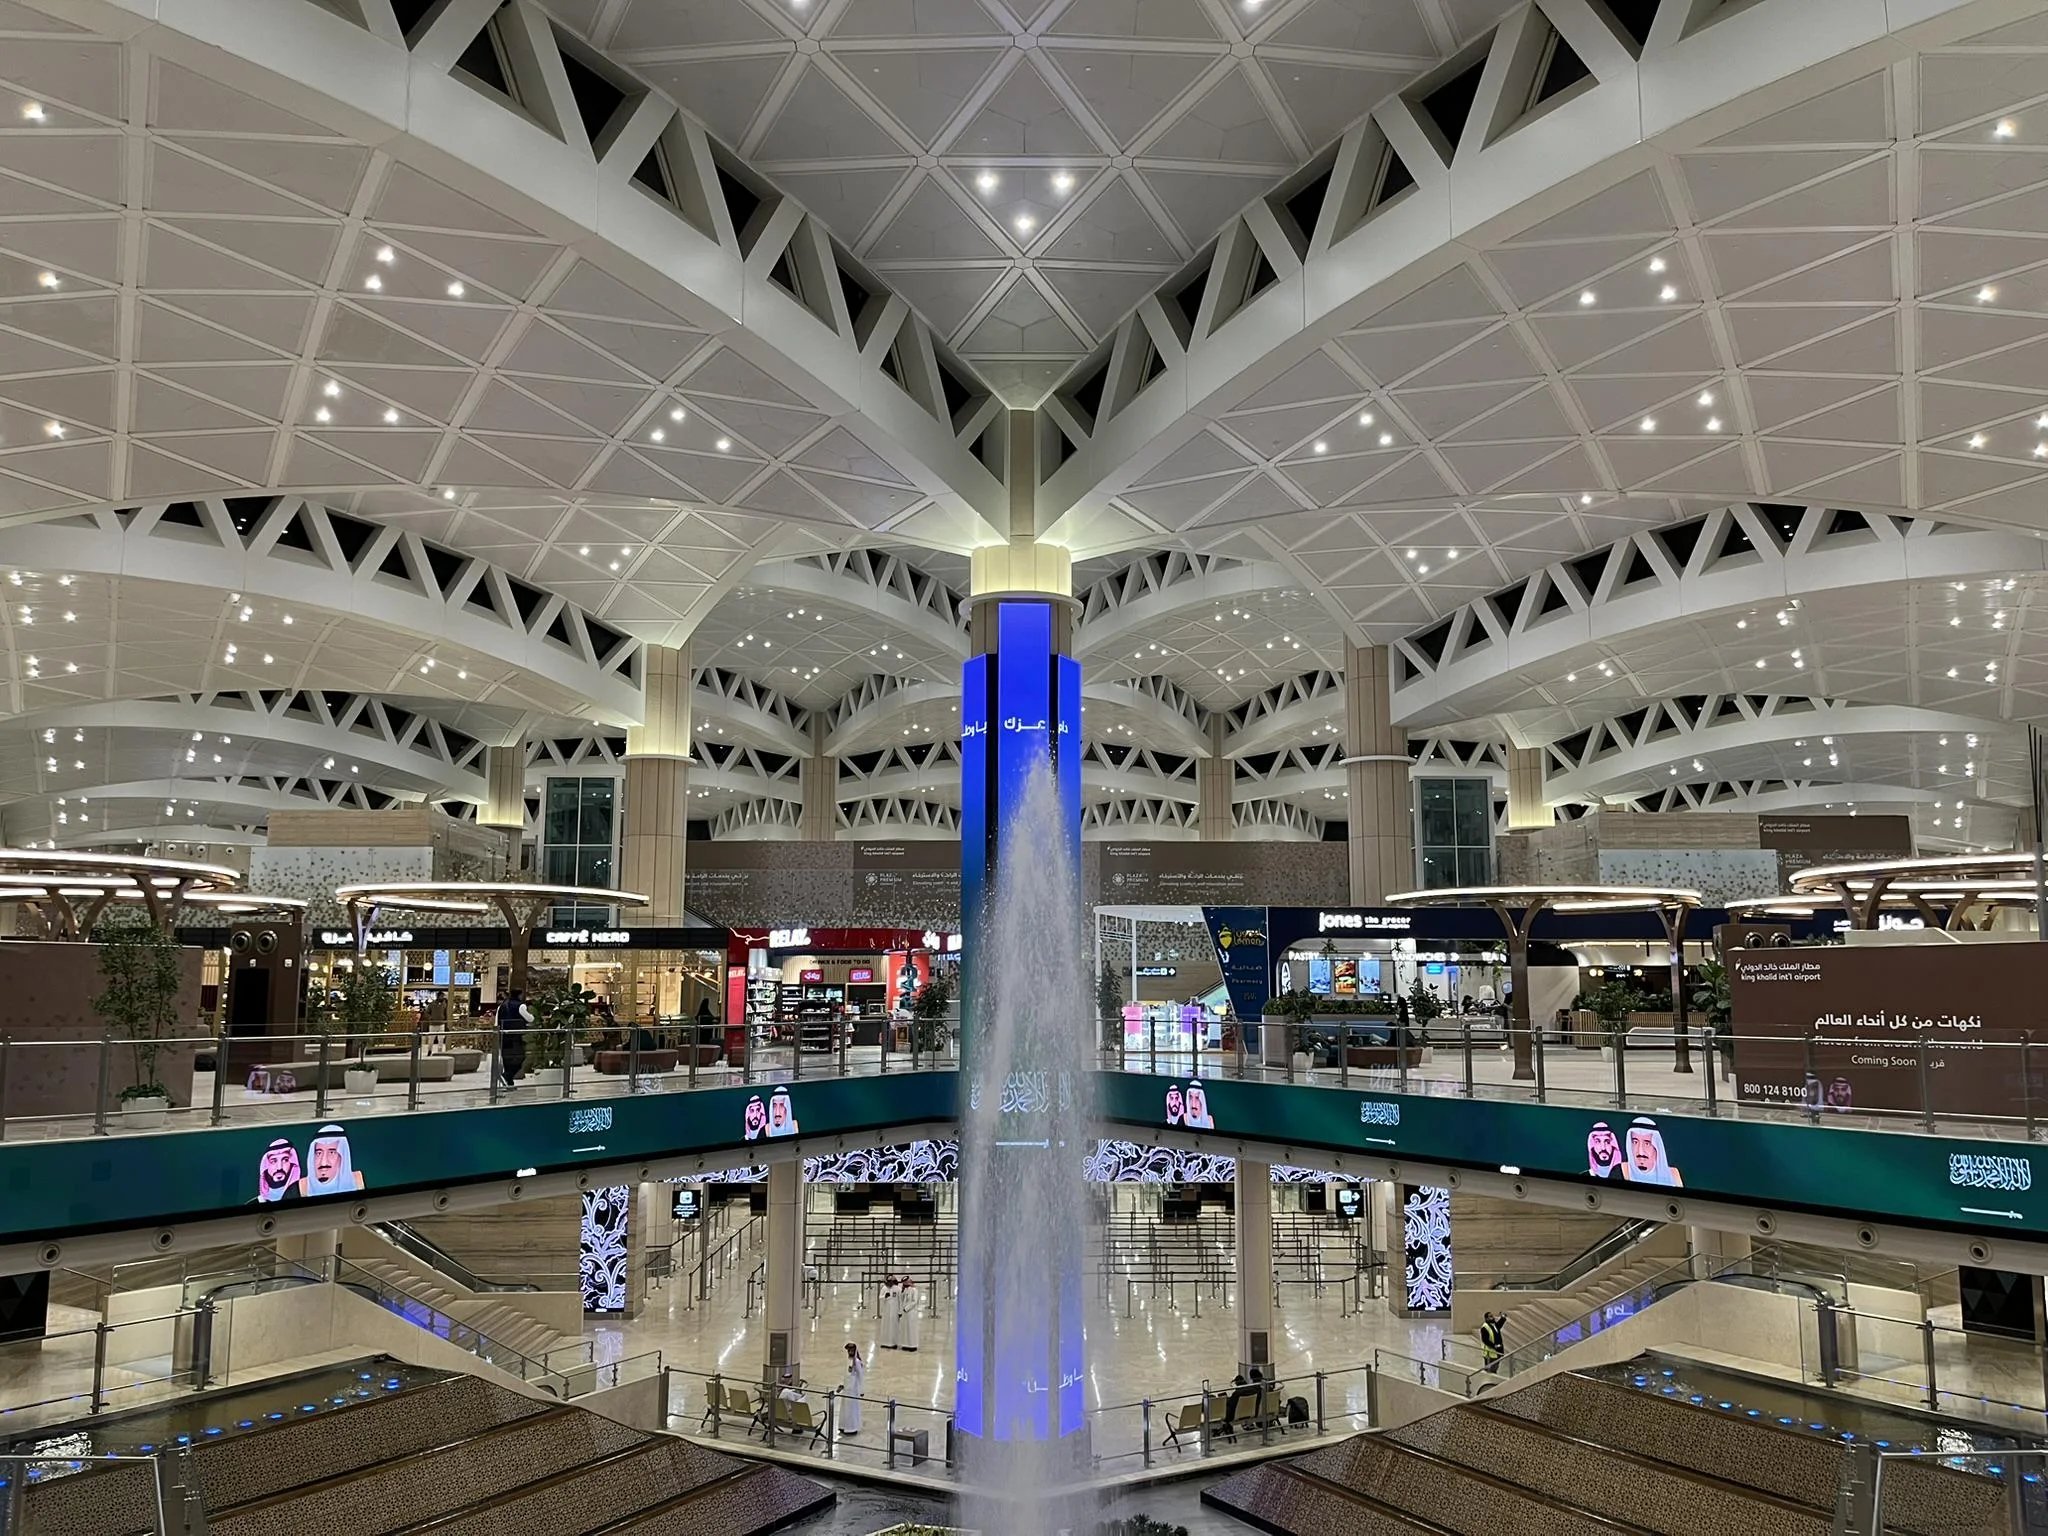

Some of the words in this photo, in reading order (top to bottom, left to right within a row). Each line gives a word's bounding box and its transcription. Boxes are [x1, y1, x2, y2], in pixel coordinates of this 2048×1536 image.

[1319, 912, 1363, 932] jones
[1288, 951, 1320, 960] PASTRY
[1740, 963, 1763, 974] الدولي
[1801, 963, 1821, 972] مطار
[1741, 973, 1756, 983] king
[1794, 973, 1821, 982] airport
[1814, 1014, 1852, 1030] العالم
[1856, 1010, 1885, 1026] أنحاء
[1889, 1015, 1908, 1030] كل
[1911, 1016, 1933, 1029] من
[1937, 1015, 1982, 1032] نكهات
[1851, 1055, 1889, 1068] Coming
[1891, 1056, 1917, 1066] Soon
[1743, 1083, 1761, 1094] 800
[1763, 1084, 1780, 1096] 124
[1781, 1086, 1808, 1097] 8100
